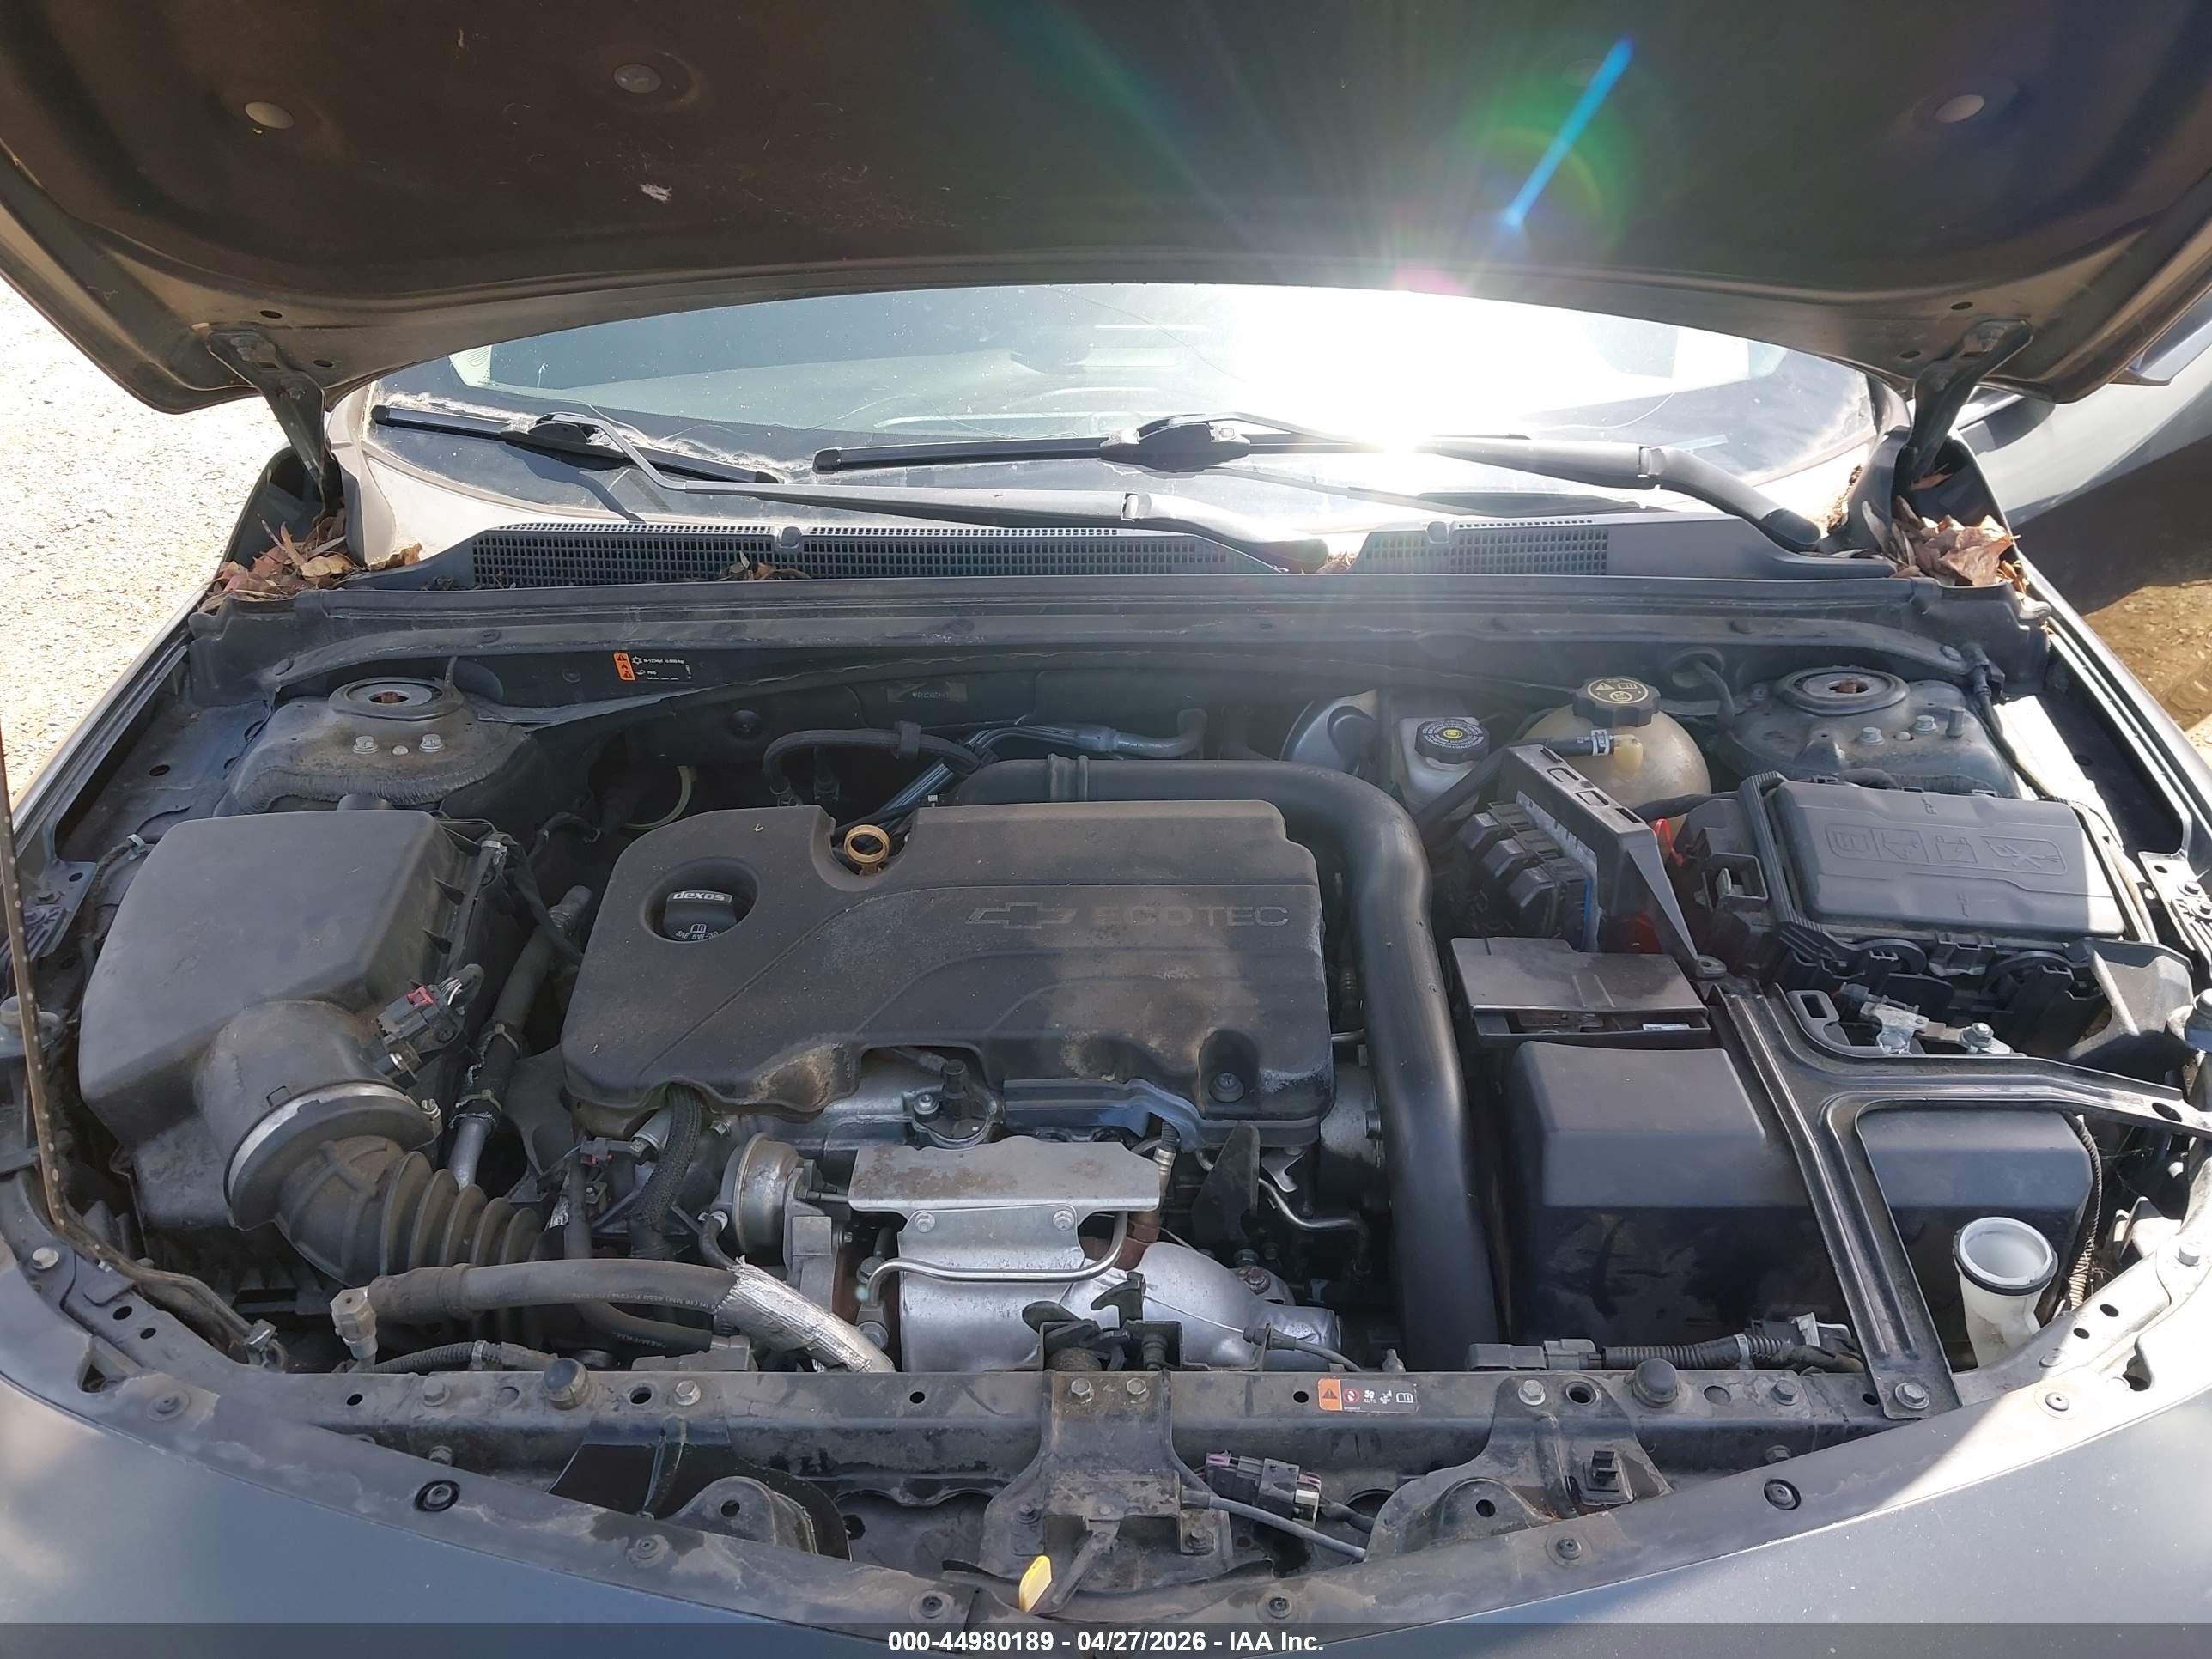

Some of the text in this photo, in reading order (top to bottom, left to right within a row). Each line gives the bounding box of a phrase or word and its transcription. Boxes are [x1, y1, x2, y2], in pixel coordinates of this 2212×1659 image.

[672, 891, 726, 901] dexos
[1092, 906, 1289, 927] ECOTEC
[675, 930, 690, 939] SAE
